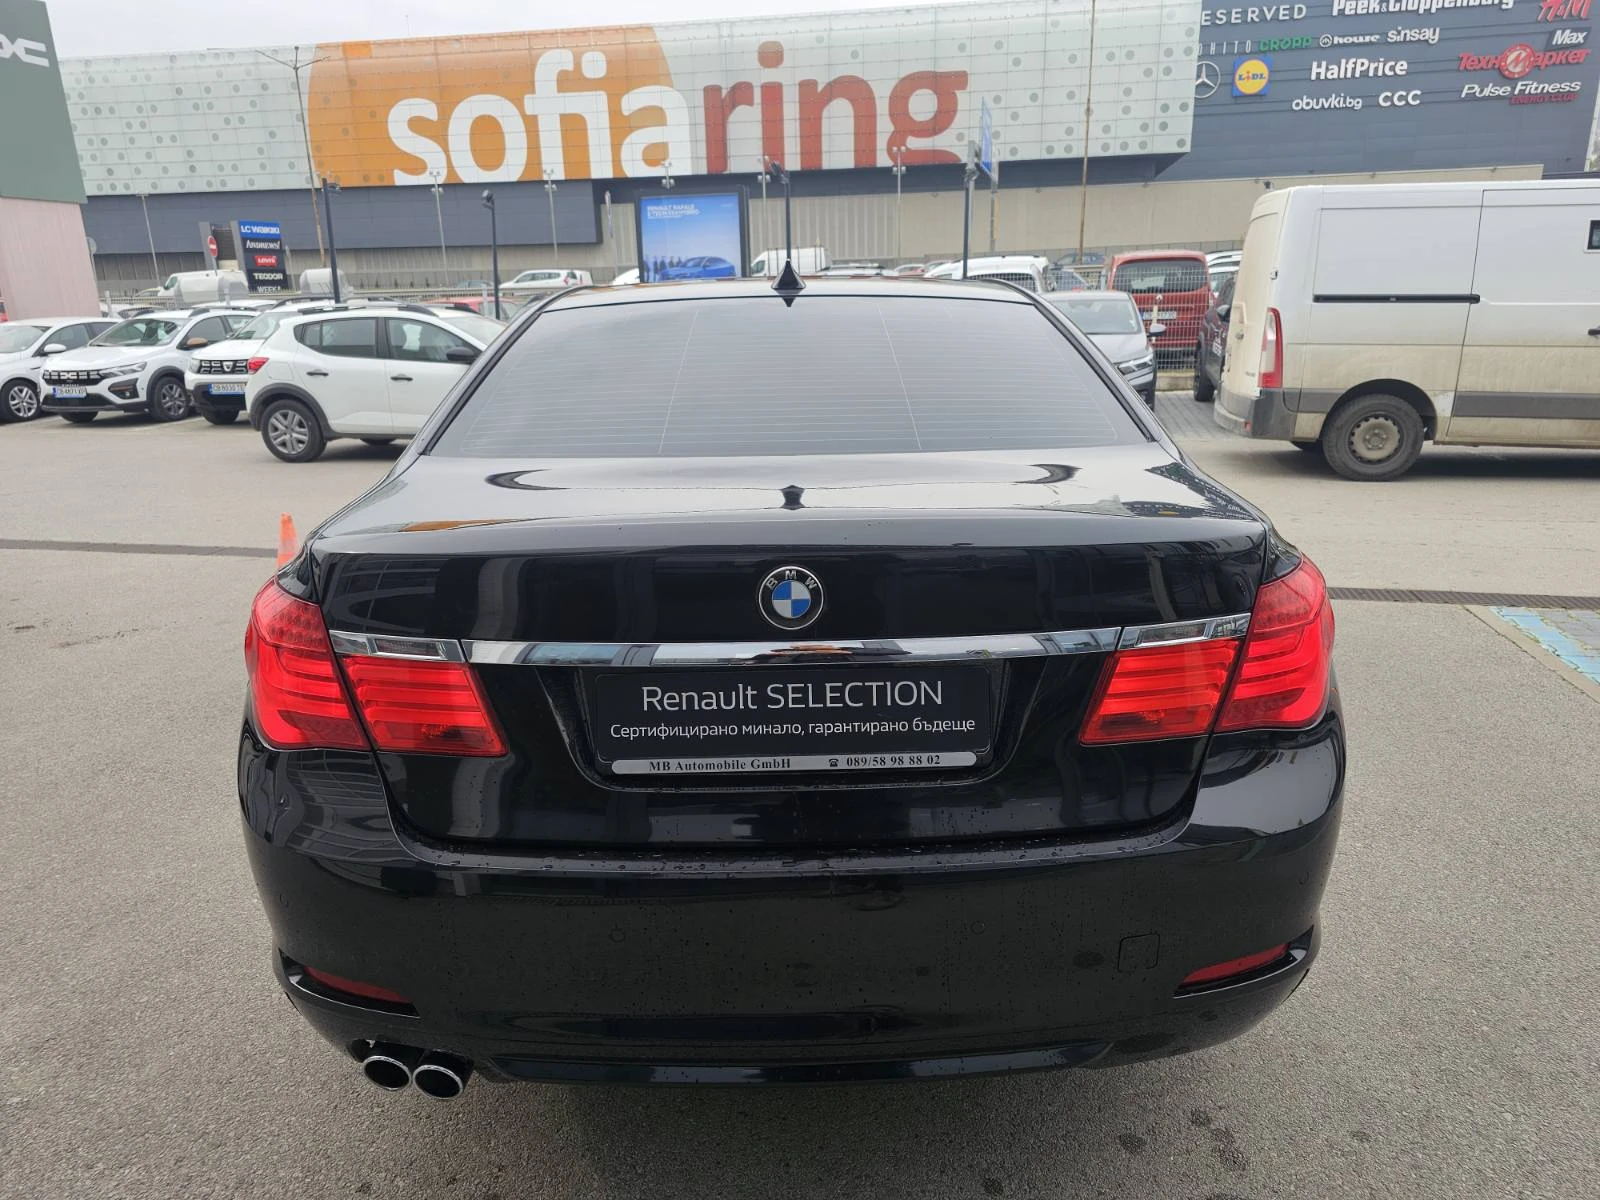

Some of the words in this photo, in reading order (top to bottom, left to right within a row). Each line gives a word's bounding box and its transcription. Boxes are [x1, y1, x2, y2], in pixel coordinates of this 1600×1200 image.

[1259, 35, 1312, 51] CROPP
[1387, 26, 1440, 44] sinsay
[1552, 29, 1588, 45] Max
[1311, 58, 1408, 81] HalfPrice
[1461, 83, 1511, 98] Pulse
[1514, 80, 1581, 95] Fitness
[1292, 93, 1363, 111] obuvki.bg
[1378, 90, 1422, 107] CCC
[766, 569, 818, 590] BMW
[642, 683, 758, 711] Renault
[766, 680, 943, 709] SELECTION
[610, 723, 738, 740] Сертифицирано
[742, 723, 805, 736] минало,
[809, 720, 909, 736] гарантирано
[912, 717, 976, 733] бъдеще
[650, 760, 670, 772] MB
[675, 759, 747, 771] Automobile
[750, 758, 791, 769] GmbH
[846, 756, 886, 767] 089/58
[890, 755, 904, 766] 98
[909, 755, 922, 765] 88
[927, 754, 941, 765] 02
